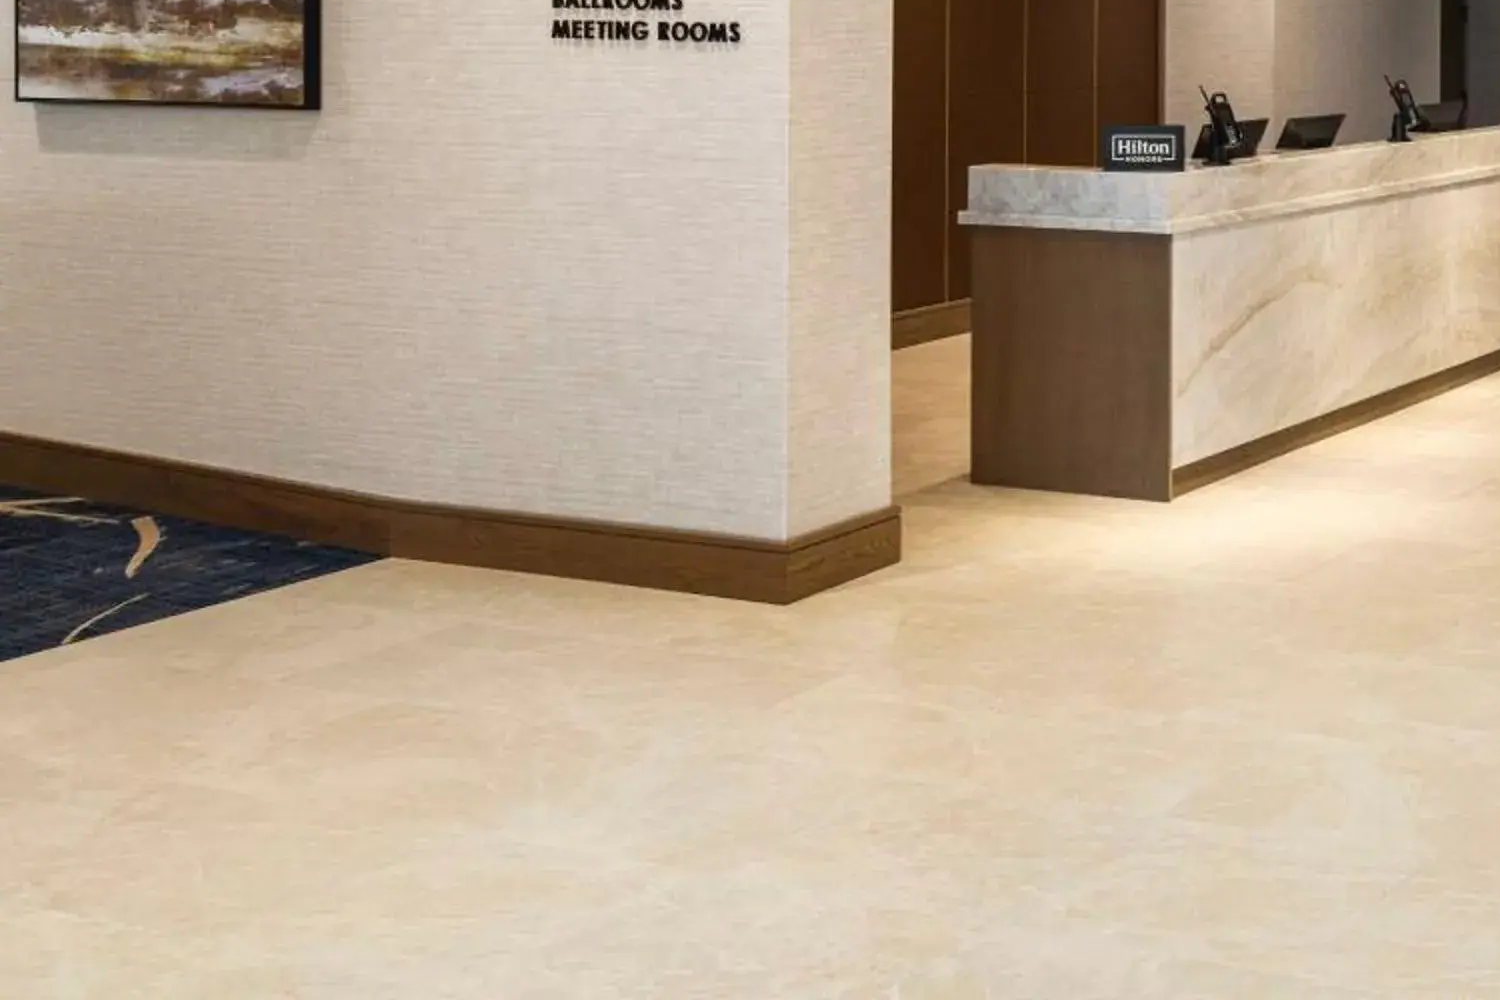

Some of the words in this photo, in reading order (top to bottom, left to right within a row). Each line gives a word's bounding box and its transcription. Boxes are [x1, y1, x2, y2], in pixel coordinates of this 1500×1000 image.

[551, 20, 649, 40] MEETING
[657, 22, 741, 42] ROOMS
[1118, 139, 1169, 154] Hilton
